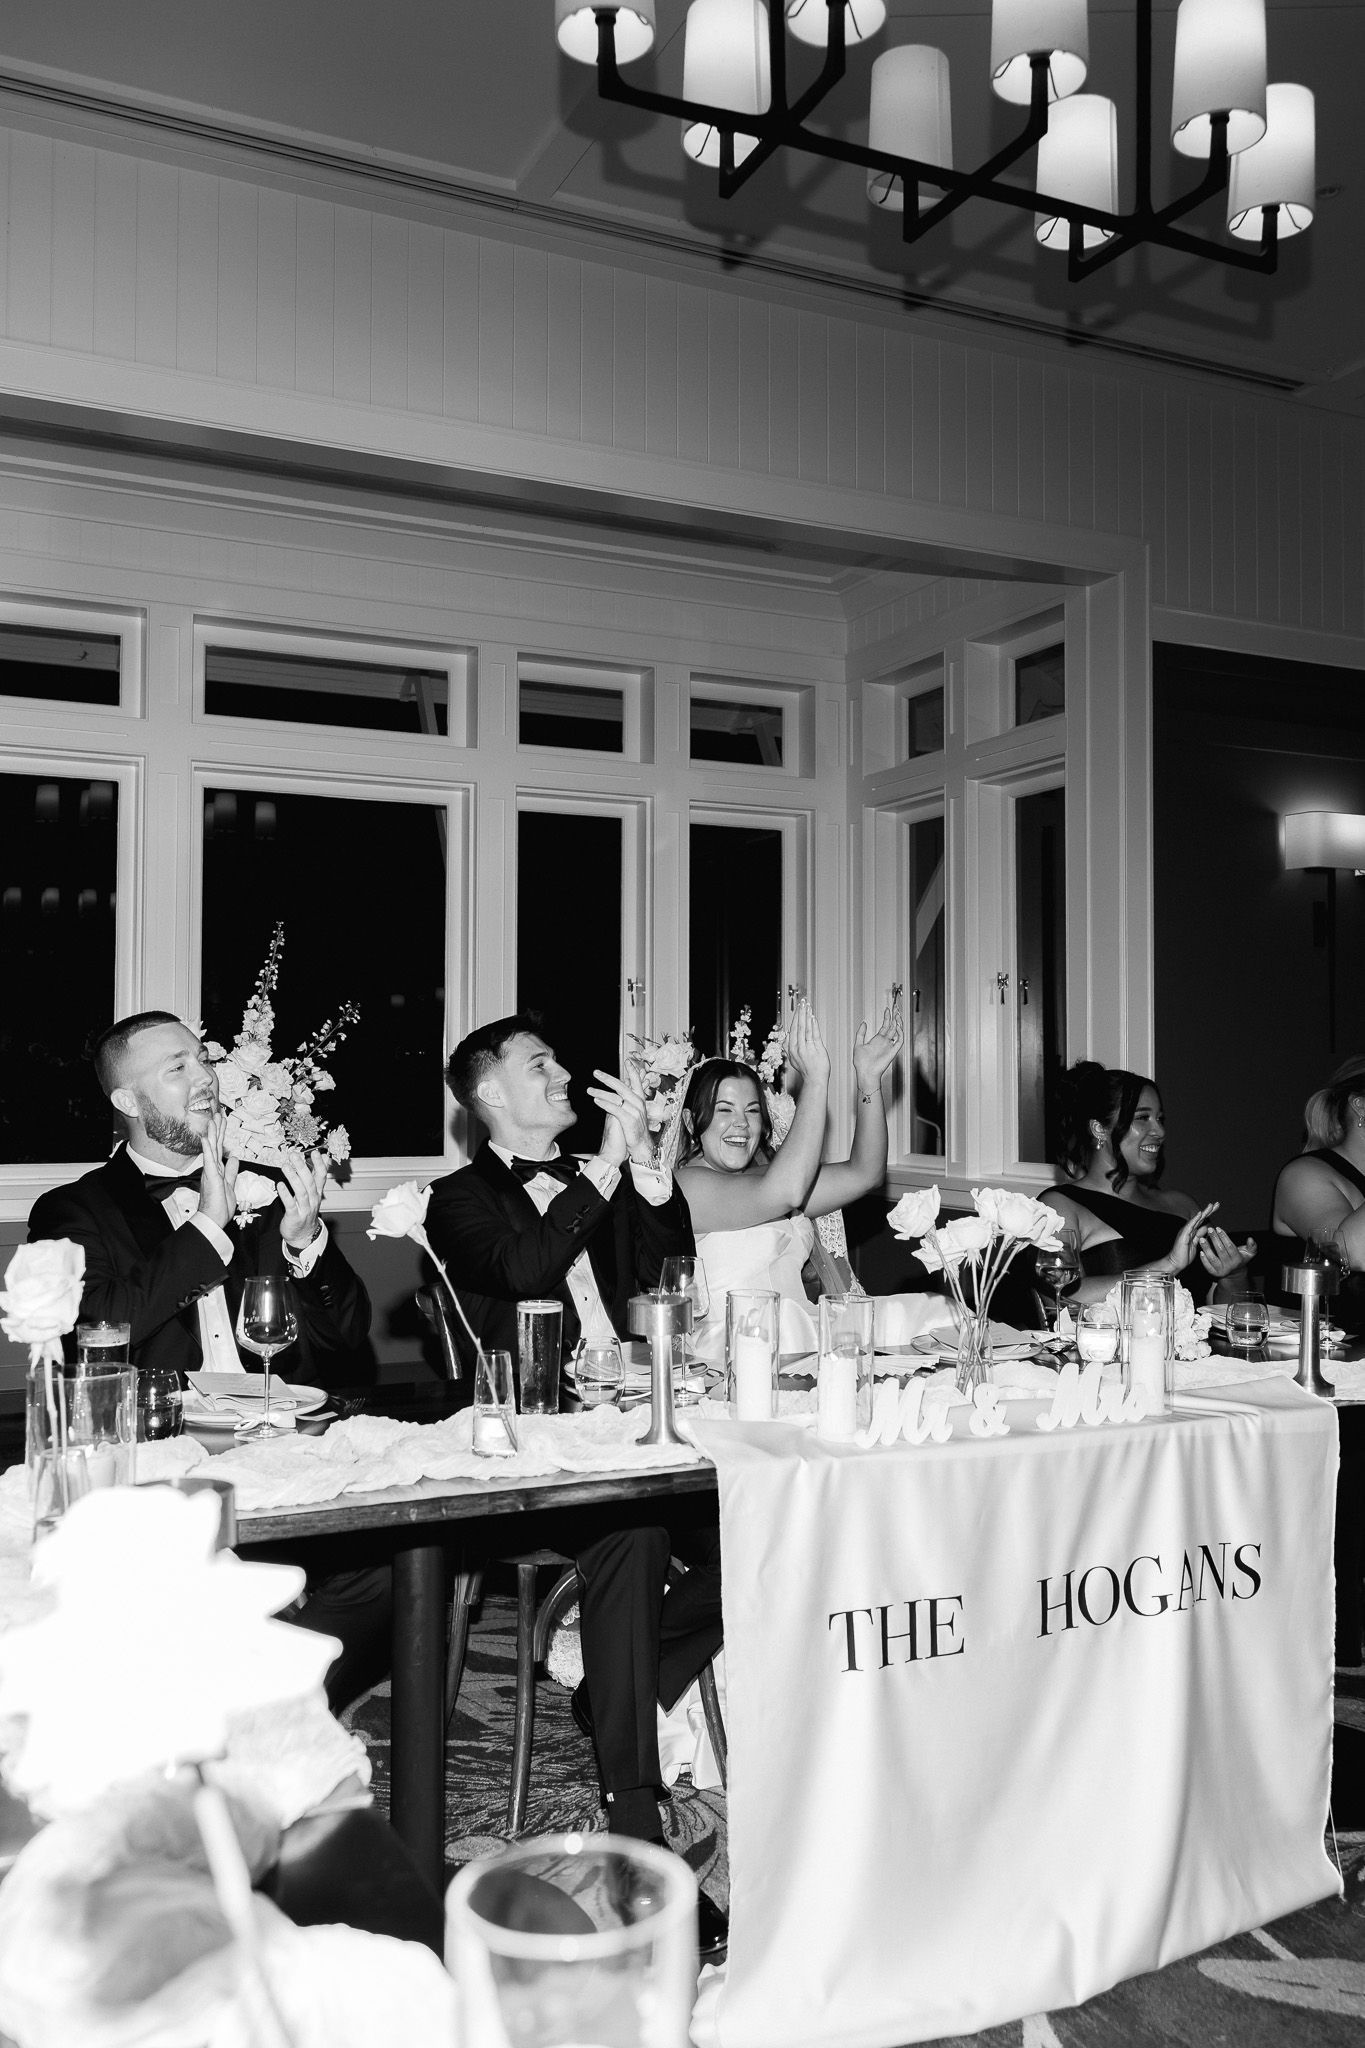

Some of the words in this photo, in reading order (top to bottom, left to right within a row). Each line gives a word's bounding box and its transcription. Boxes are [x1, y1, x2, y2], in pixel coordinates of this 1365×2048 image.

[855, 1377, 954, 1449] Mr
[969, 1382, 1010, 1437] &
[1036, 1361, 1148, 1431] Mrs
[828, 1595, 965, 1673] THE
[1036, 1542, 1262, 1639] HOGANS
